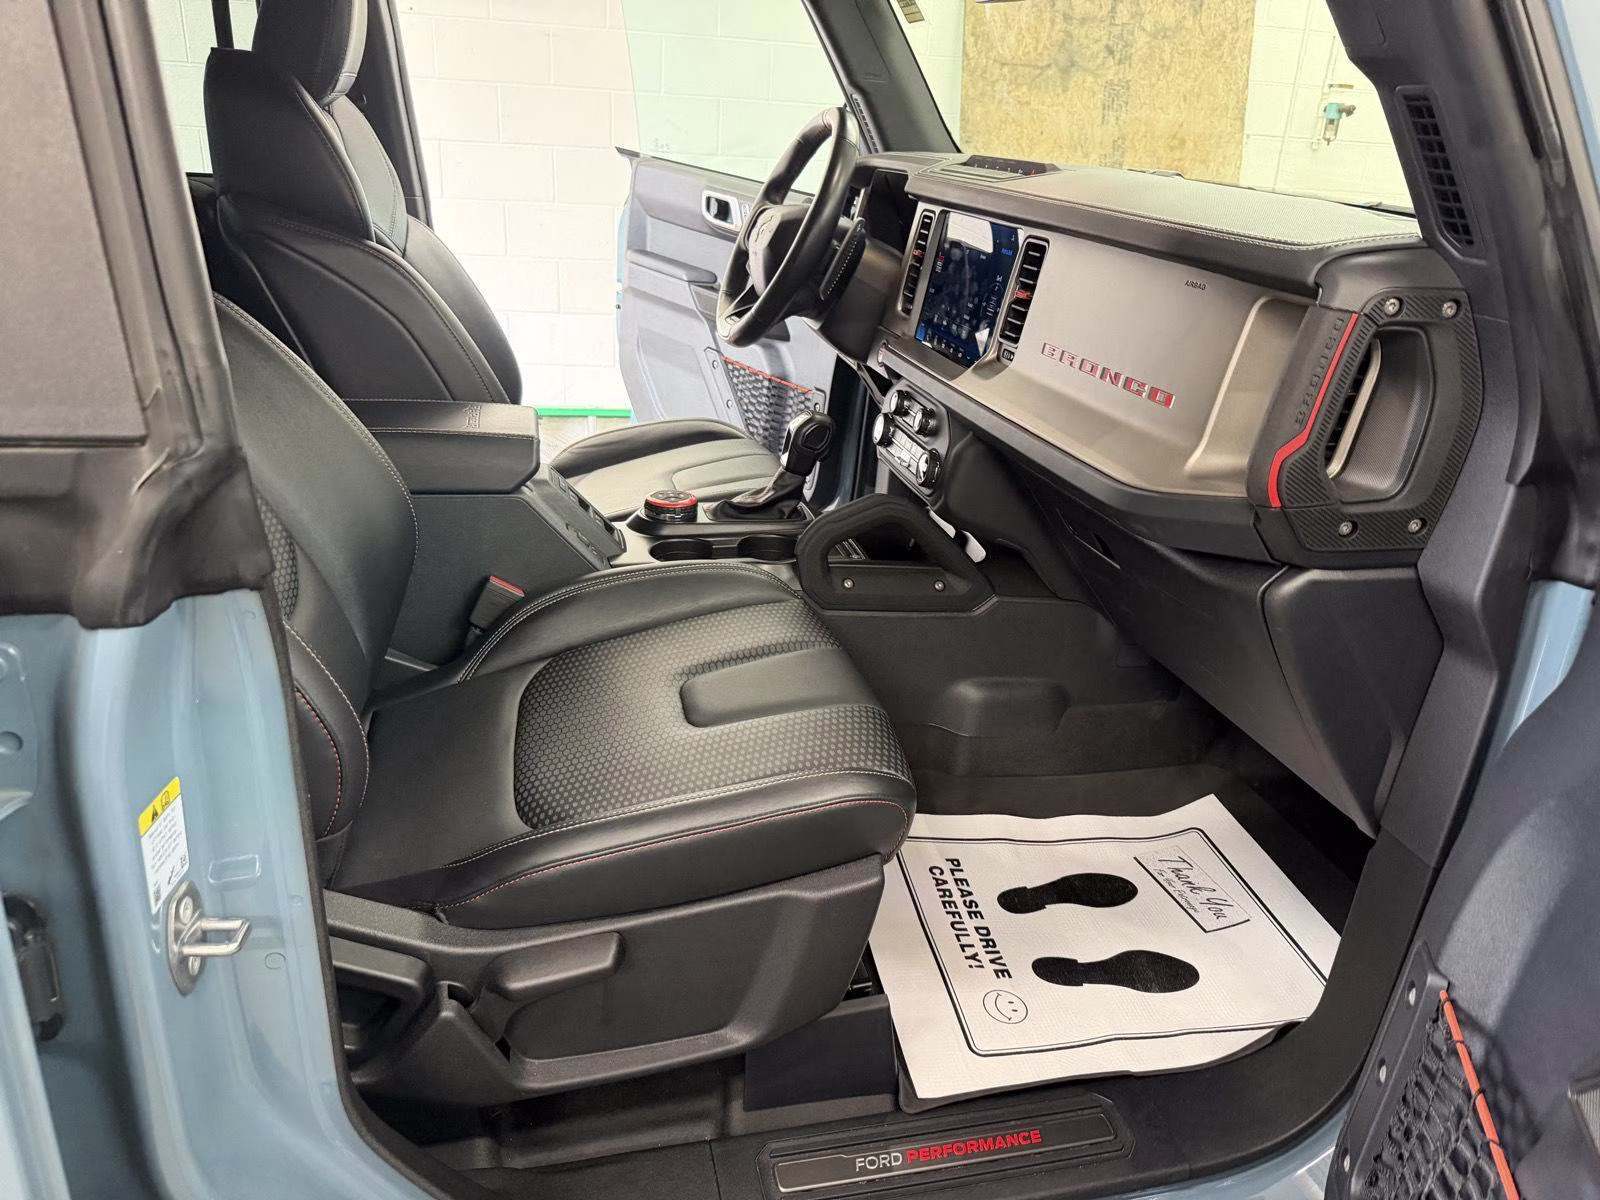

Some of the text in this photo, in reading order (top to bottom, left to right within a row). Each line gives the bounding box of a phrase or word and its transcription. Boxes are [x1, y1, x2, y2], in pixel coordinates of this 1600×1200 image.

[1184, 280, 1207, 291] AIRBAG
[1041, 342, 1176, 409] BRONCO
[928, 865, 985, 969] CAREFULLY!
[945, 858, 1013, 980] PLEASE DRIVE
[1157, 855, 1234, 920] Thank You
[855, 1129, 1042, 1172] FORD PERFORMANCE
